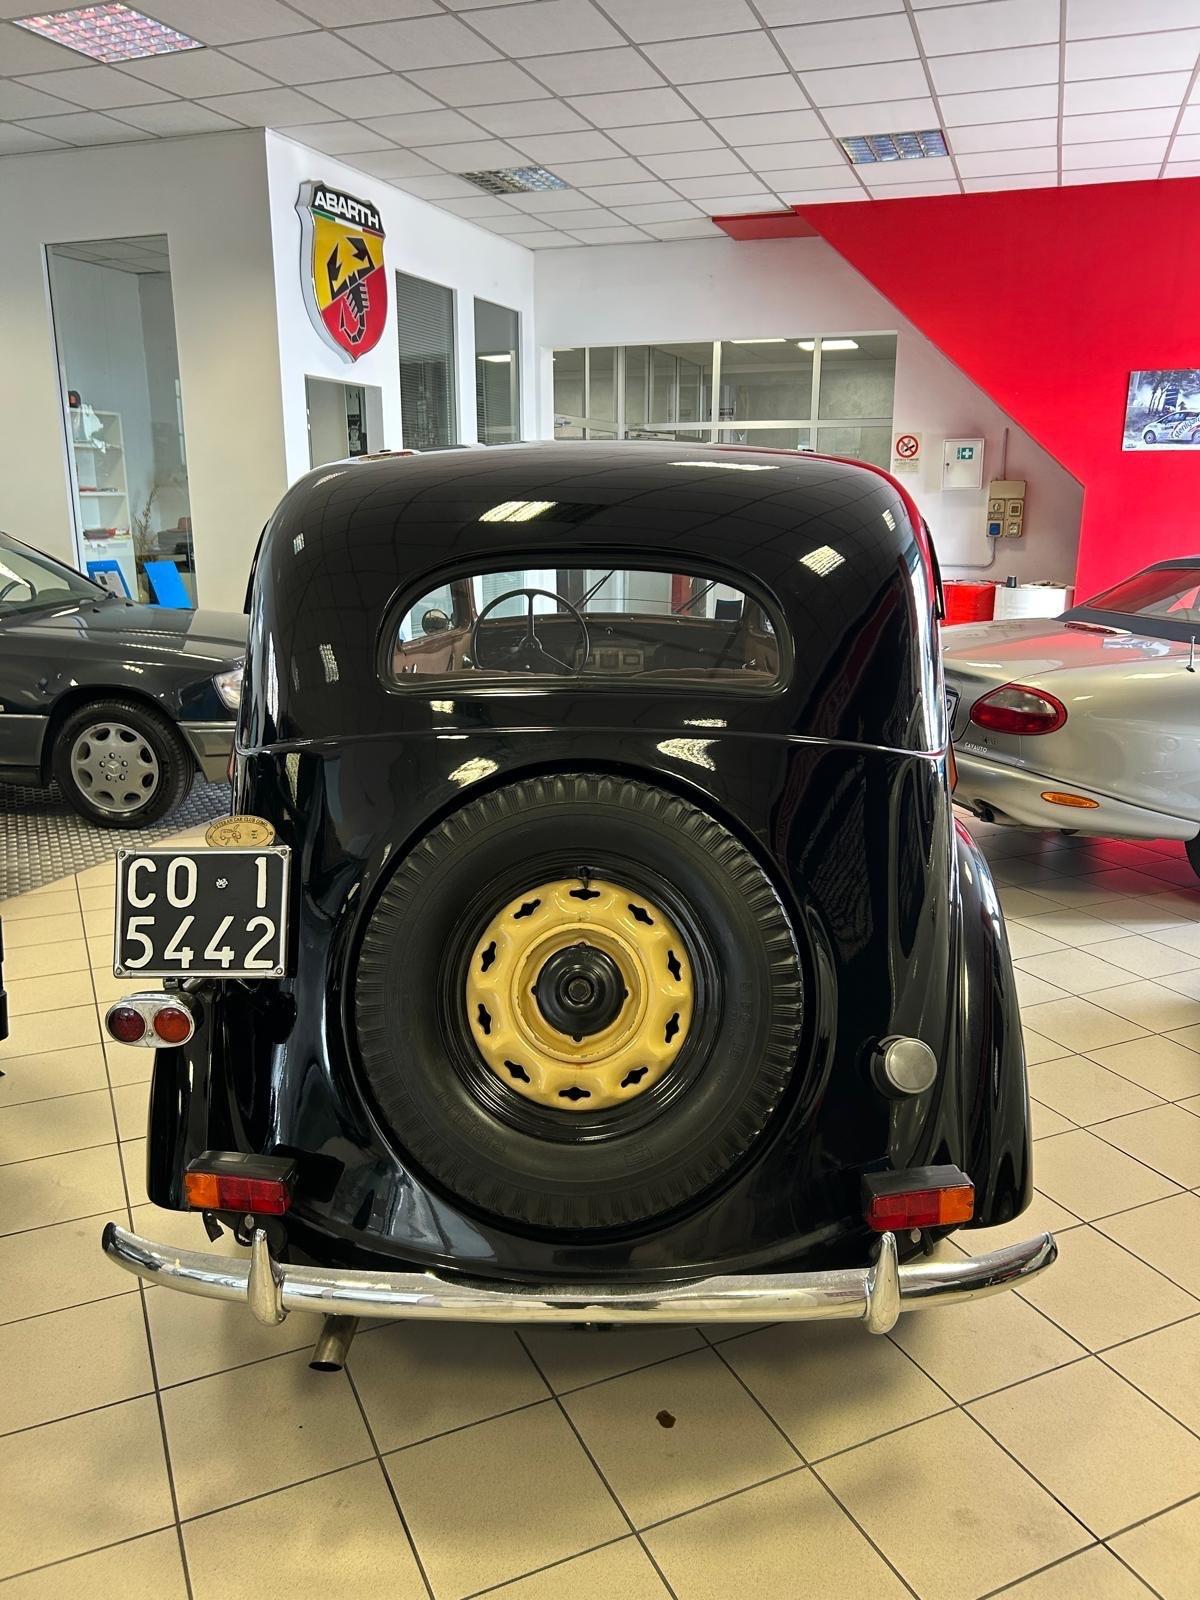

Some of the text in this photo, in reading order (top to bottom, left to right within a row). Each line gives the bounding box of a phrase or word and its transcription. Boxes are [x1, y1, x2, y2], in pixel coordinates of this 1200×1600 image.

[314, 191, 379, 229] ABARTH
[213, 818, 233, 829] VETERAN
[127, 856, 267, 909] CO 1
[124, 915, 276, 969] 5442
